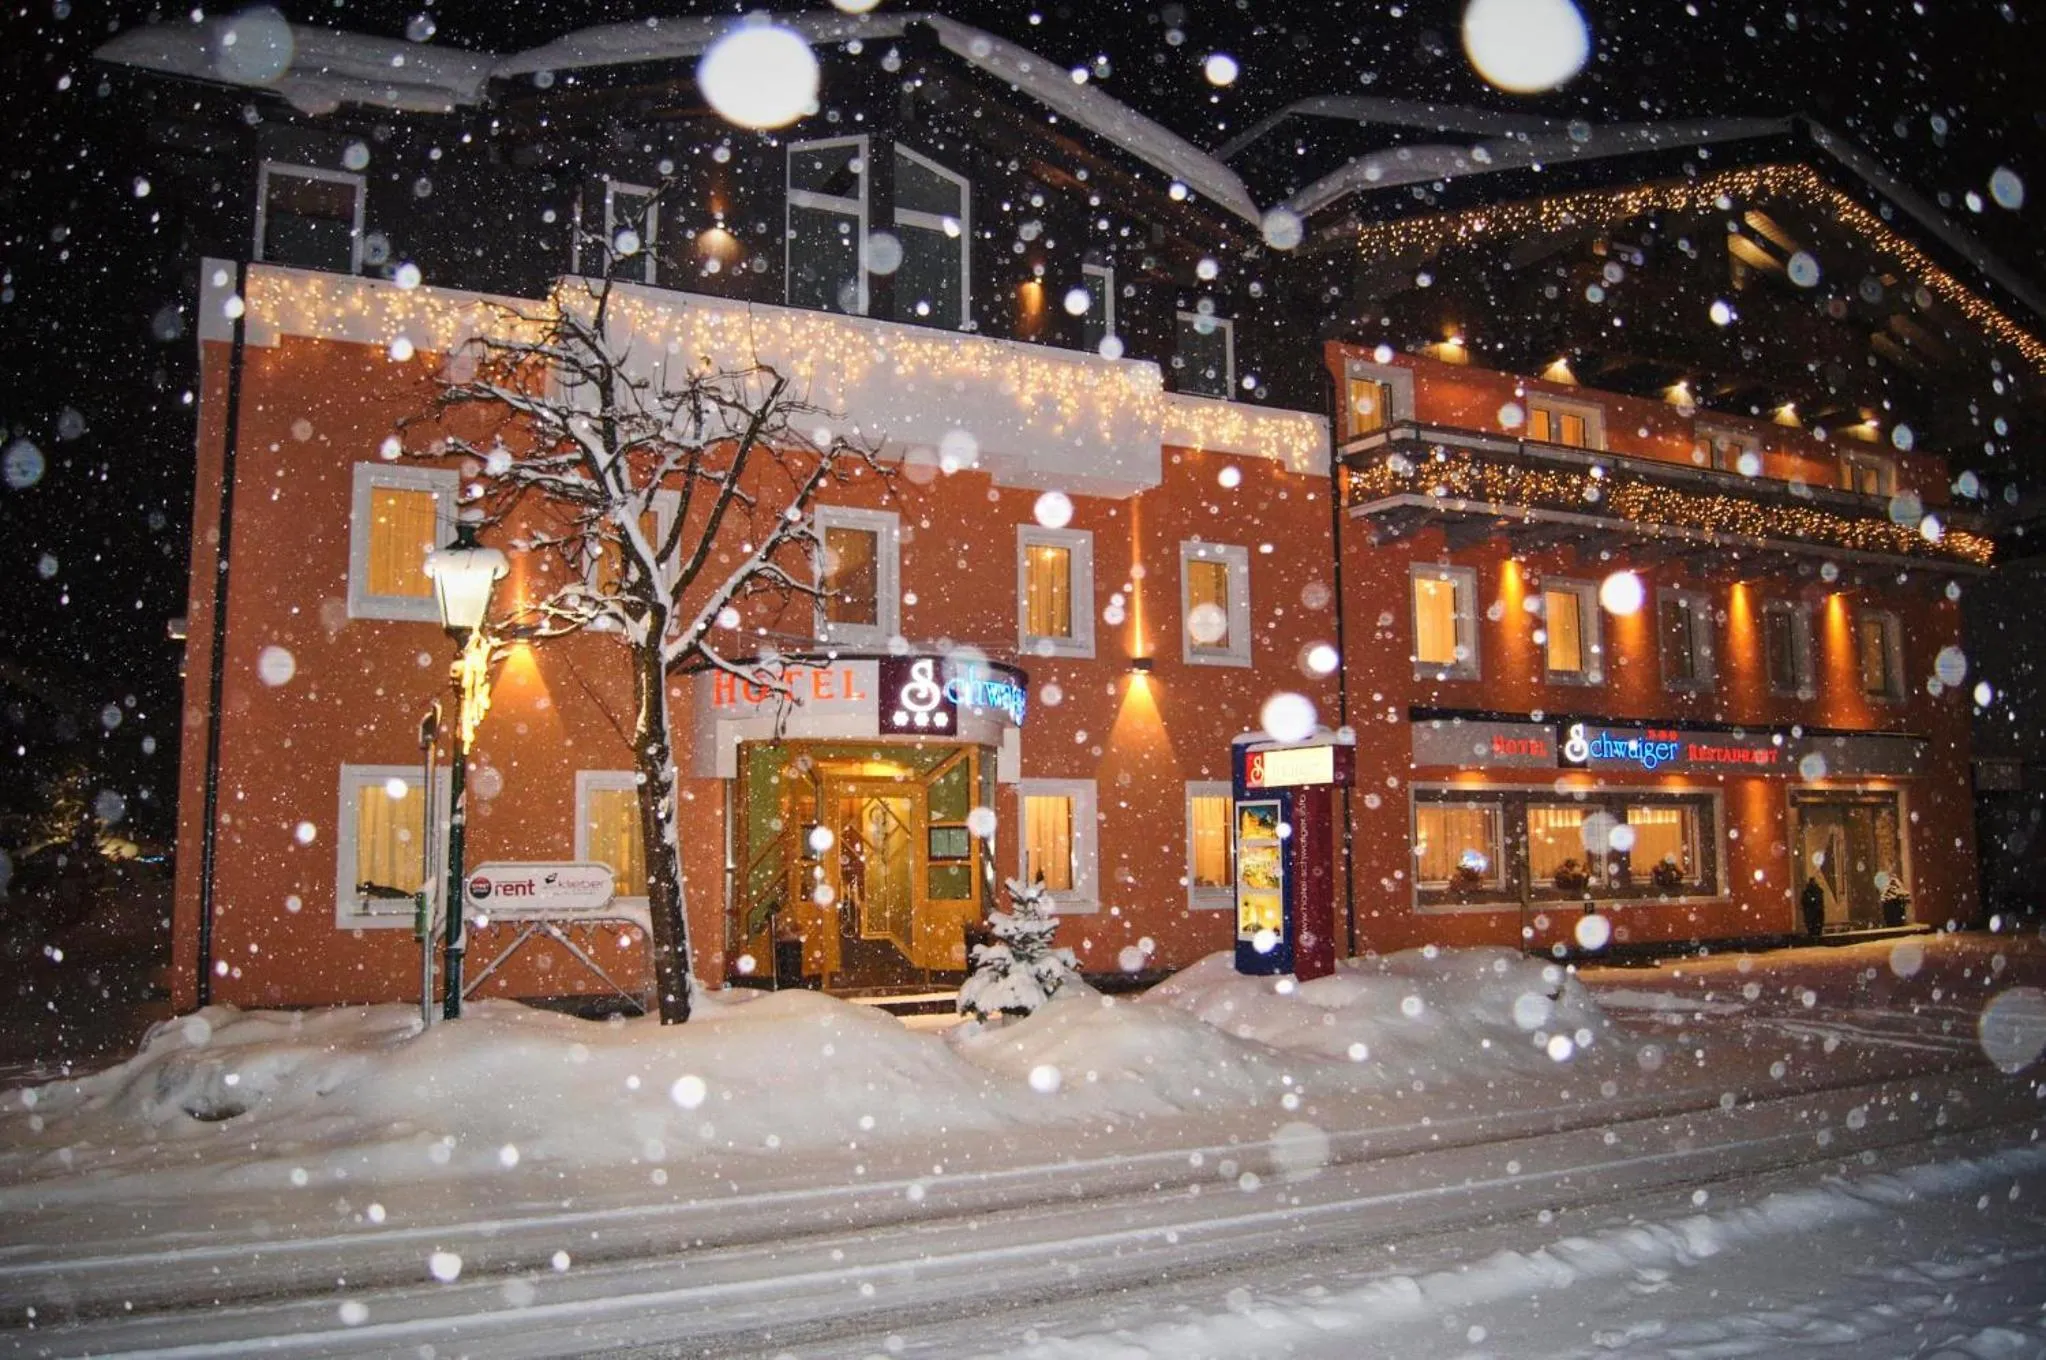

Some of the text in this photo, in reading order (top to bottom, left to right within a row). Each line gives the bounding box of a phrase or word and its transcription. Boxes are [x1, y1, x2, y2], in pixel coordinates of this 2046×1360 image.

[713, 668, 866, 706] HOTEL
[1565, 723, 1679, 769] Schwaiger
[495, 879, 535, 896] rent
